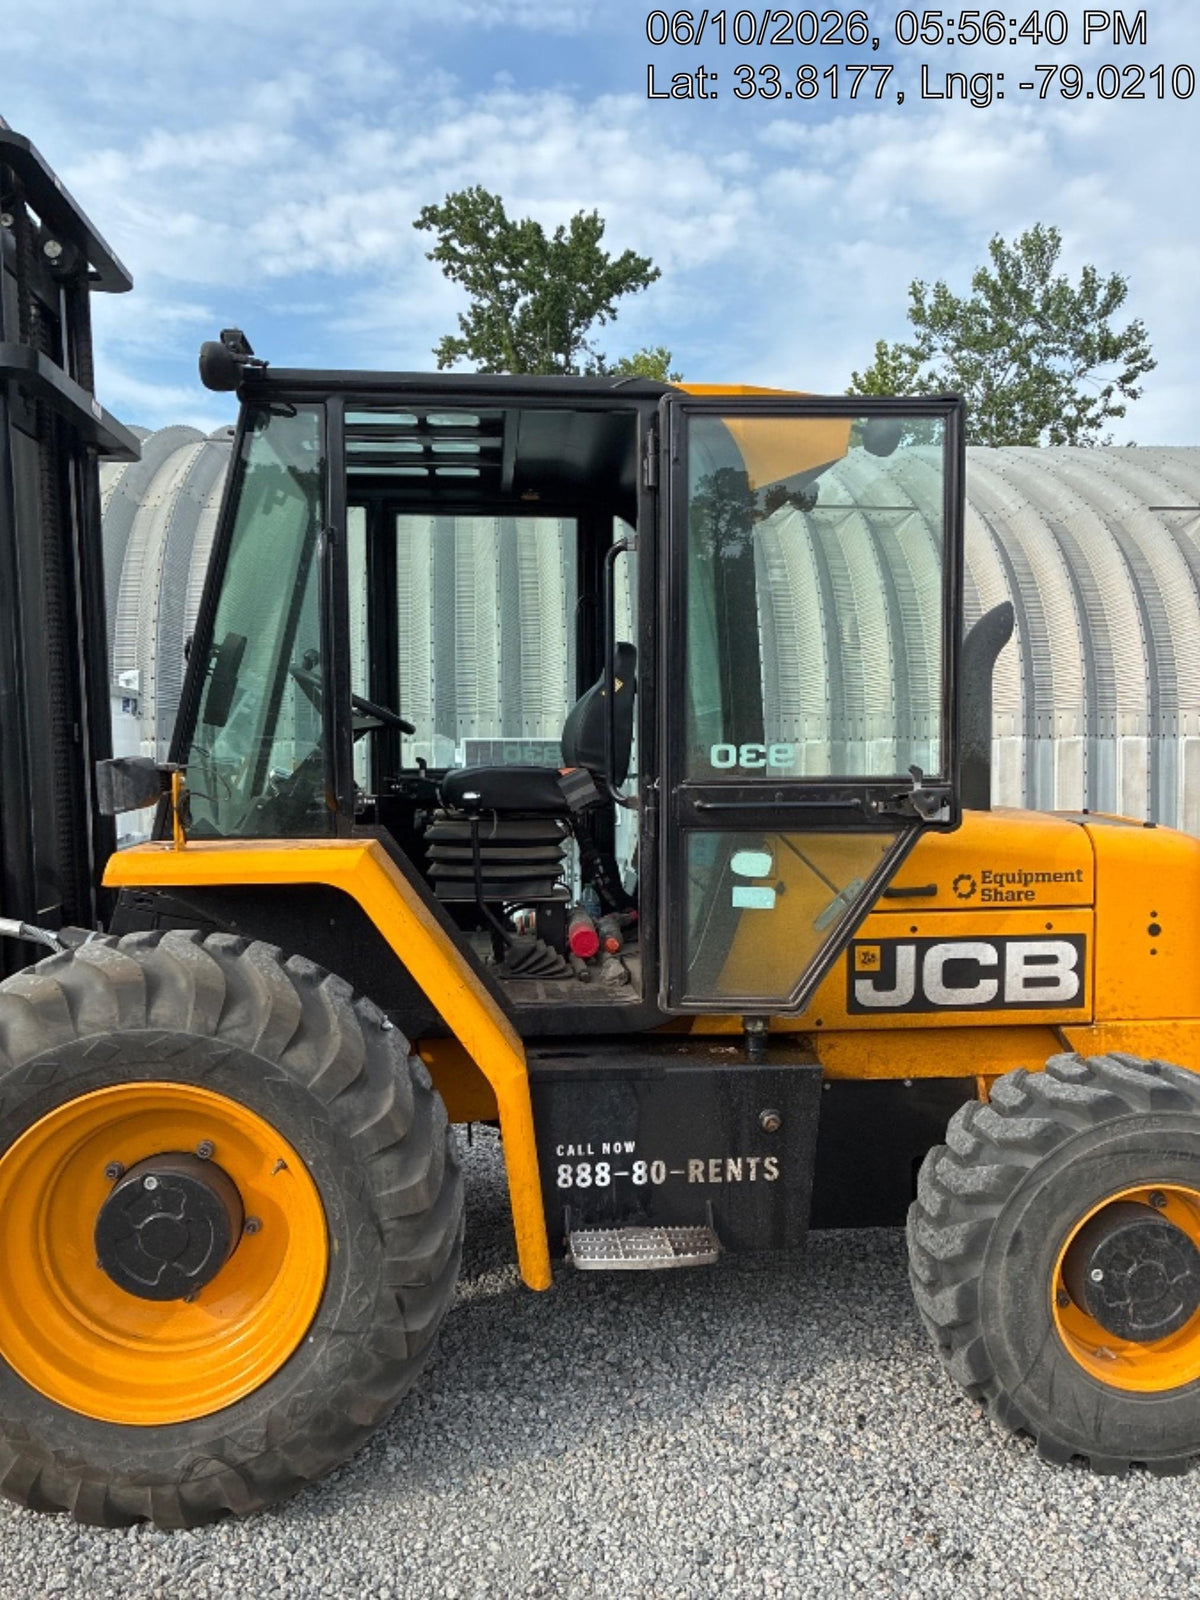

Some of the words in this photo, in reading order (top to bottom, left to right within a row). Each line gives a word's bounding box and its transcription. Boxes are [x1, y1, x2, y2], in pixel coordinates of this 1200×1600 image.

[980, 868, 1083, 886] Equipment
[980, 885, 1036, 903] Share
[854, 940, 1080, 1008] JCB
[556, 1142, 595, 1157] CALL
[602, 1140, 636, 1155] NOW
[556, 1156, 780, 1189] 888-80-RENTS
